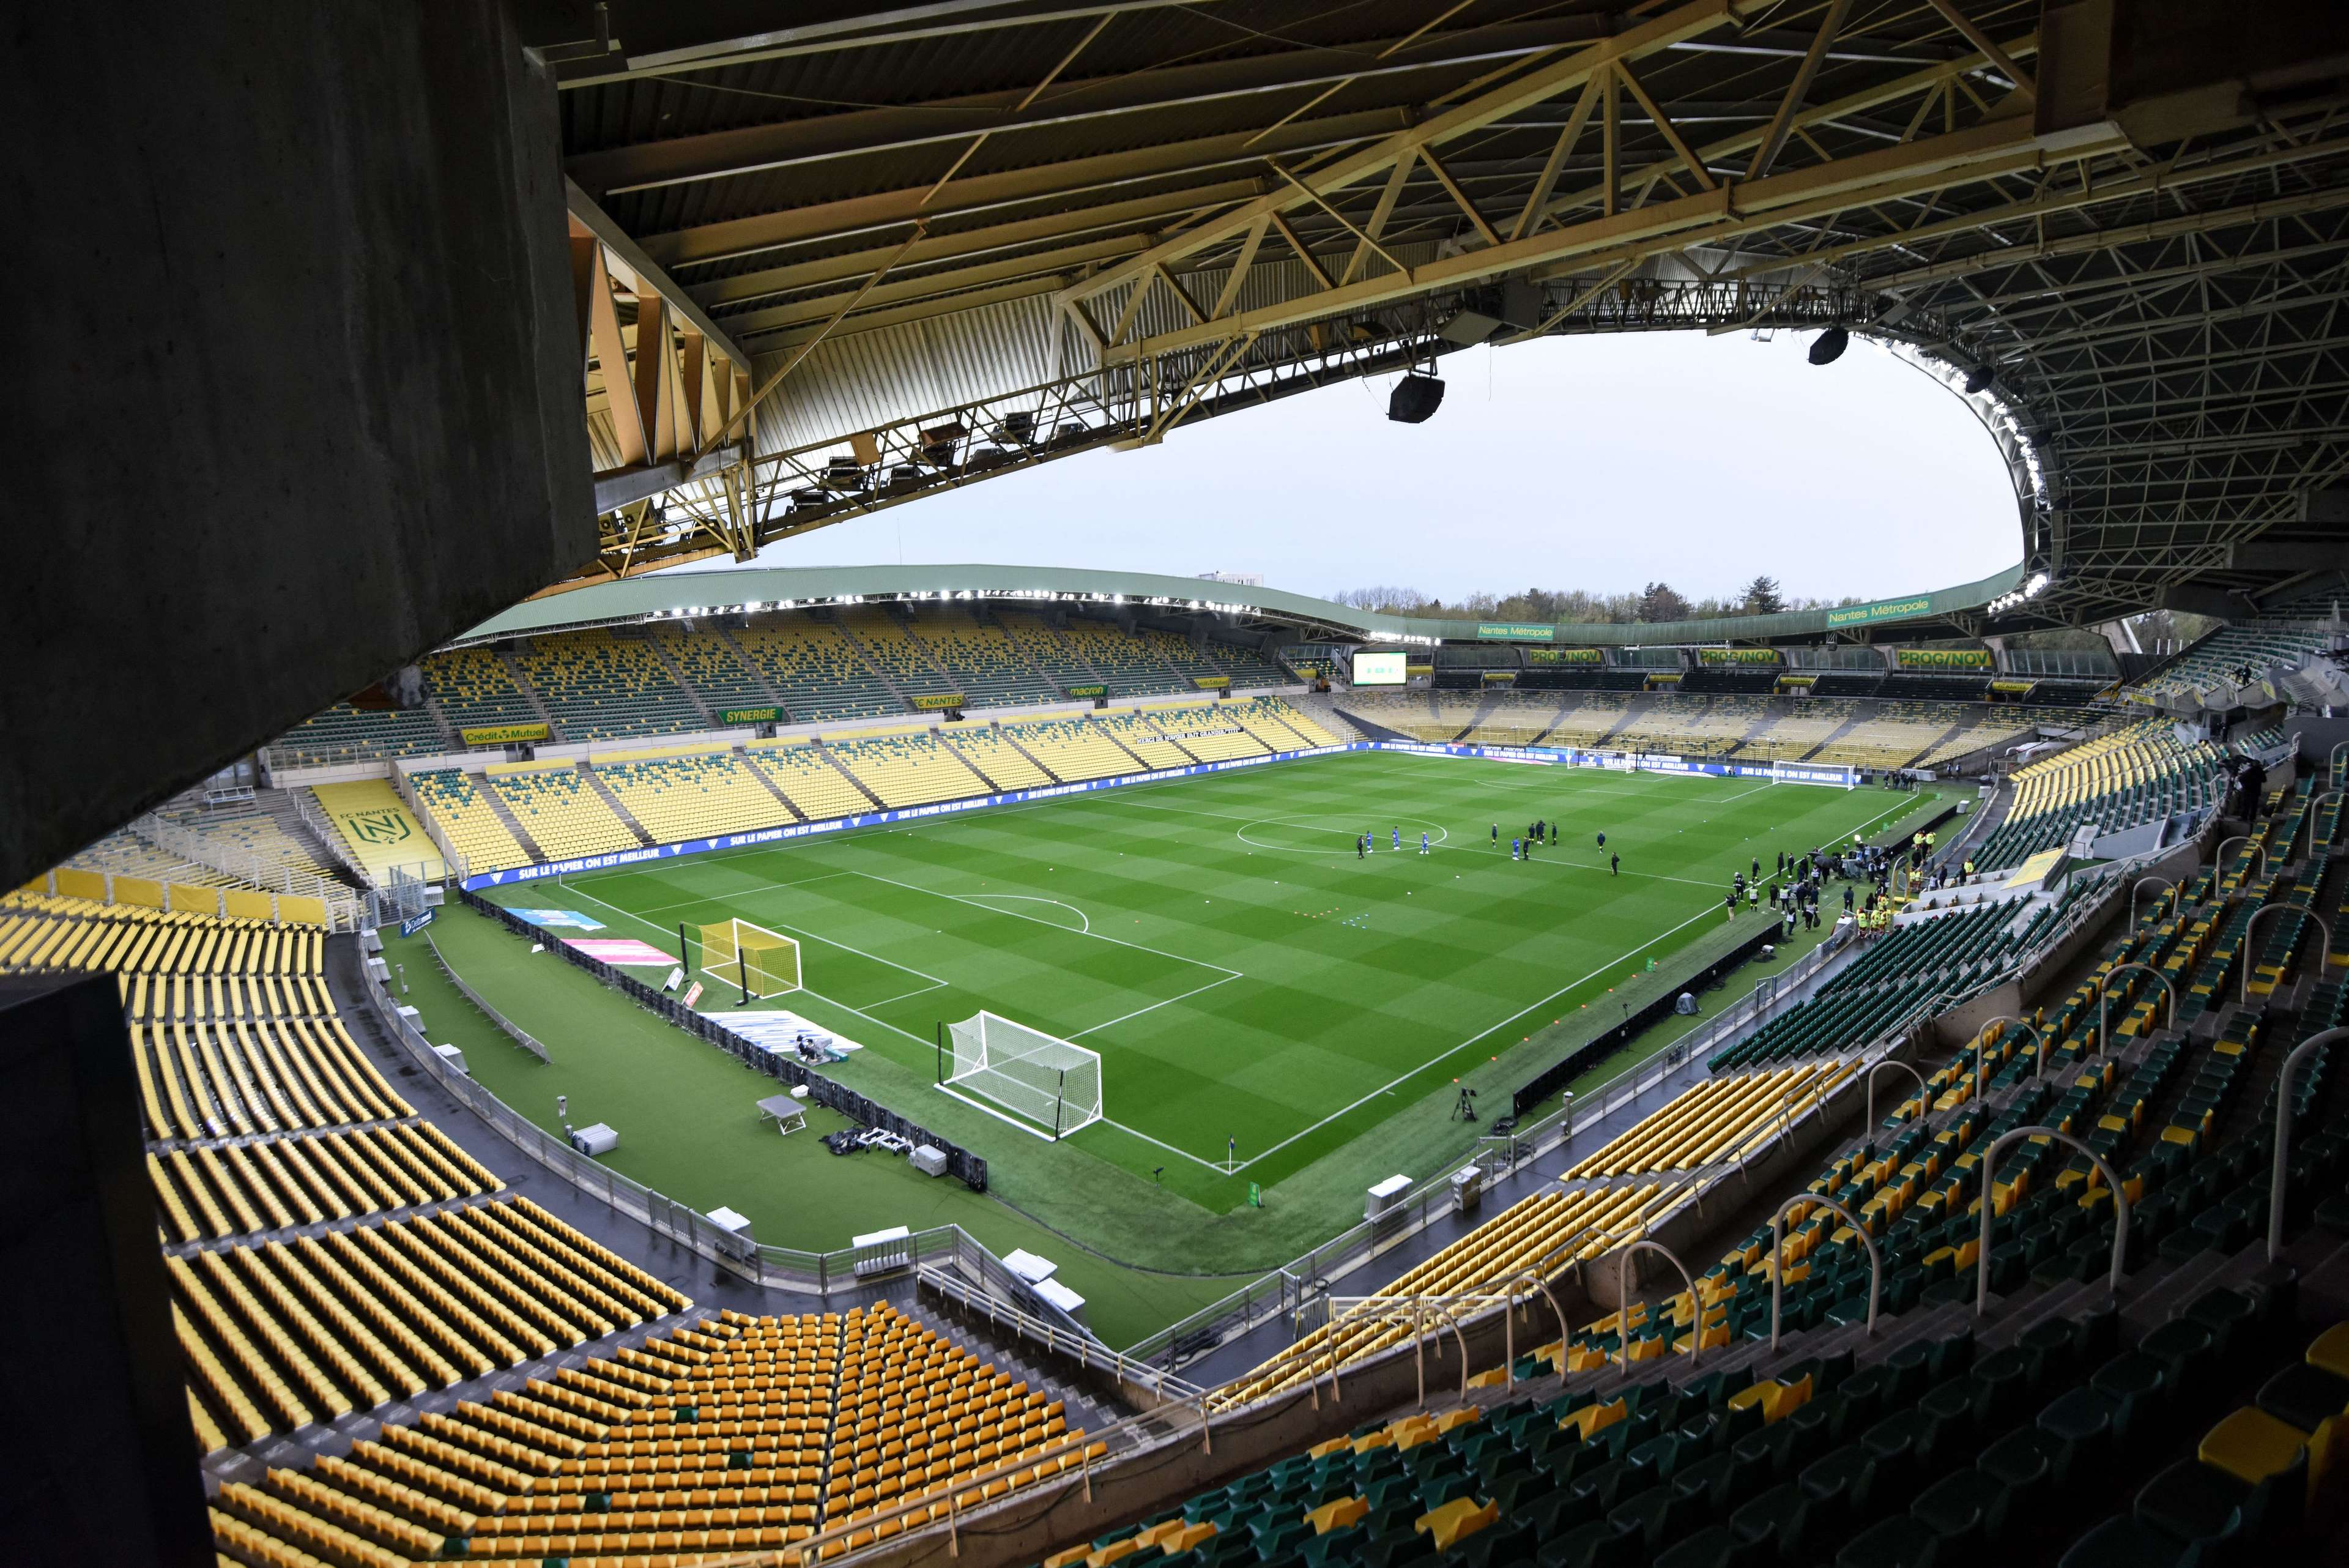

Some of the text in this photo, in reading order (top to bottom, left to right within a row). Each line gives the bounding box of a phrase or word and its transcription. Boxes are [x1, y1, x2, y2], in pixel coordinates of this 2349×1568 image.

[1830, 600, 1929, 622] Nantes Métropole
[1479, 626, 1553, 637] Nantes Métropole
[1531, 652, 1597, 661] PRO/NOV
[1701, 650, 1775, 663] PROG/NOV
[1899, 652, 1988, 664] PROG/NOV
[1071, 686, 1104, 696] macron
[926, 696, 962, 705] NANTES
[727, 709, 776, 722] SYNERGIE
[466, 728, 544, 741] Crédit Mutuel
[1812, 772, 1842, 781] MEILLEUR
[356, 808, 399, 817] NANTES
[898, 809, 910, 819] SUR
[919, 806, 940, 816] PAPIER
[940, 804, 951, 812] ON
[962, 798, 988, 809] MEILLEUR
[730, 821, 842, 845] SUR LE PAPIER ON EST MEILLEUR
[519, 849, 659, 879] SUR LE PAPIER ON EST MEILLEUR
